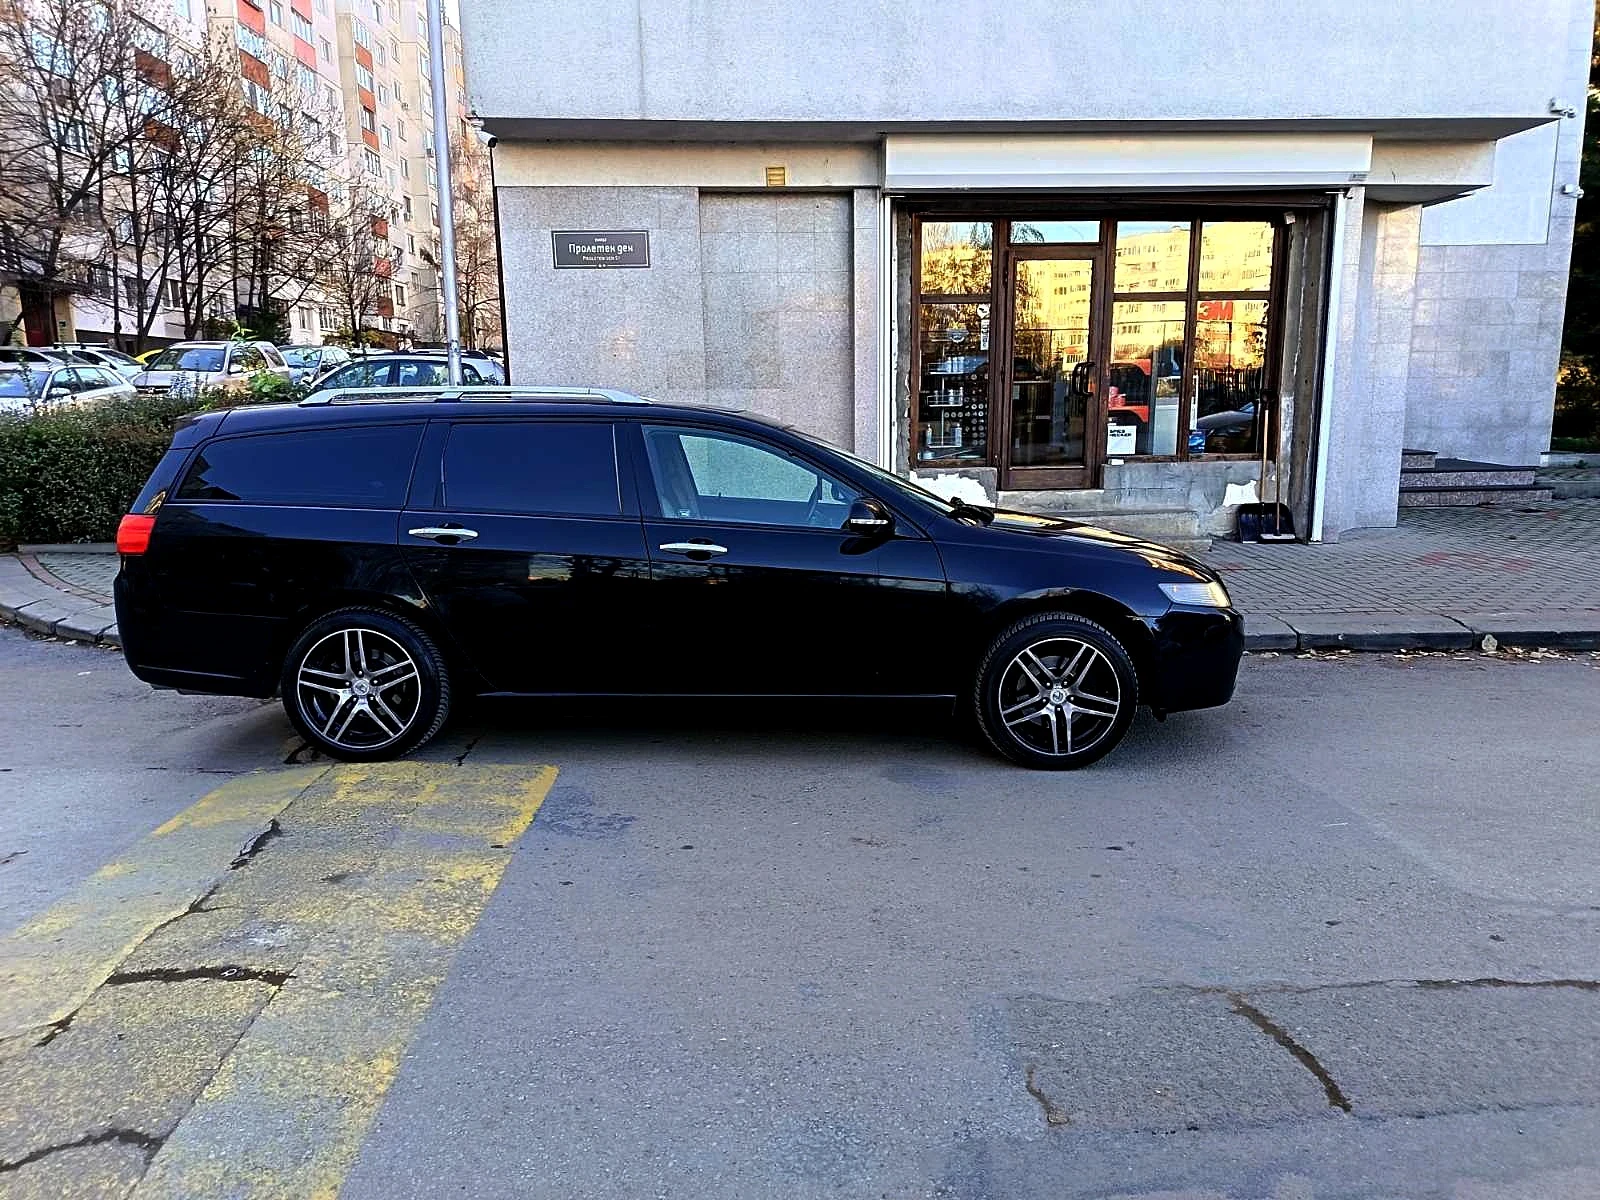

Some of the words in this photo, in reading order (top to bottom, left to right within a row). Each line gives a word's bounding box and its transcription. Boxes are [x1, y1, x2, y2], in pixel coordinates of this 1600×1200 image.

[568, 243, 616, 254] Пролетен
[617, 244, 633, 254] ден
[1198, 301, 1234, 320] 3M
